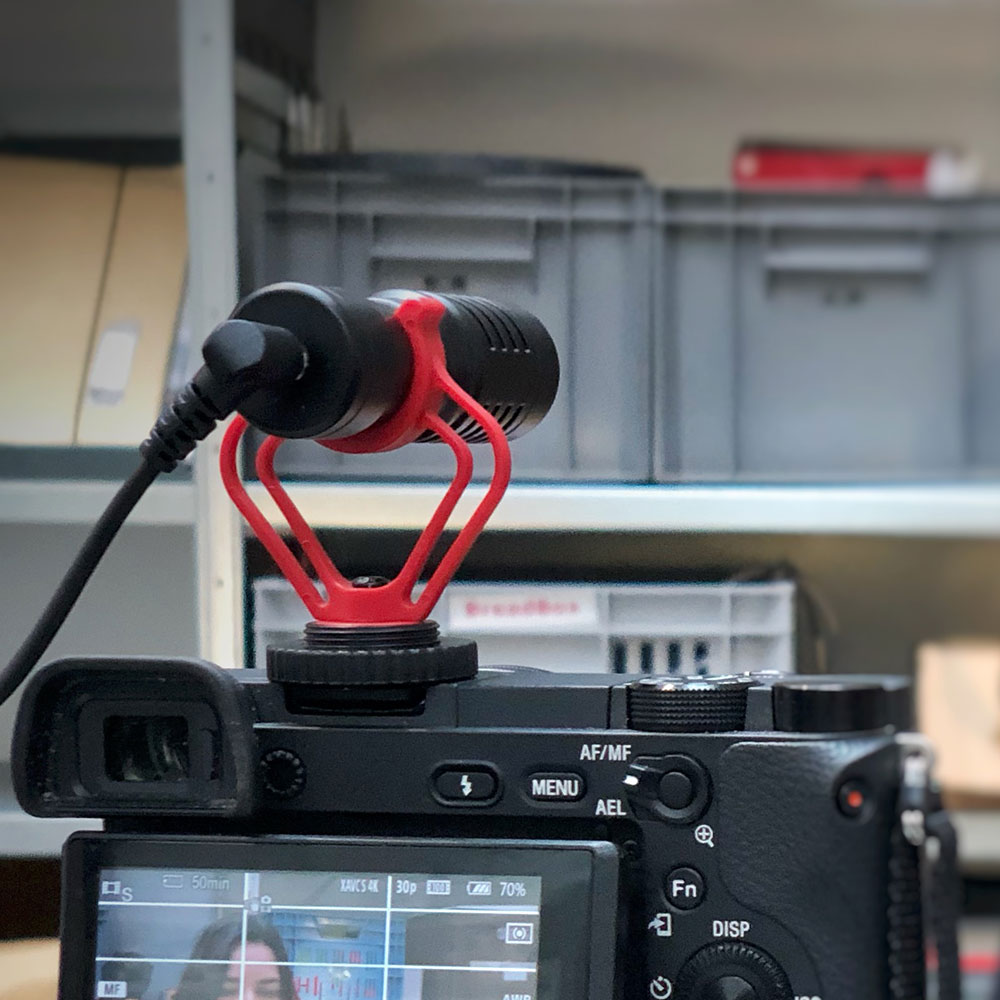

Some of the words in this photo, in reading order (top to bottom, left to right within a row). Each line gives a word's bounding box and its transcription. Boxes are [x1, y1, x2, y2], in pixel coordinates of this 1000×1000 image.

[580, 744, 632, 761] AF/MF
[532, 779, 579, 796] MENU
[595, 799, 627, 816] AEL
[191, 875, 230, 891] 50min
[396, 879, 417, 896] 30p
[500, 882, 527, 897] 70%
[672, 880, 698, 899] Fn
[712, 920, 751, 938] DISP
[104, 984, 121, 995] MF
